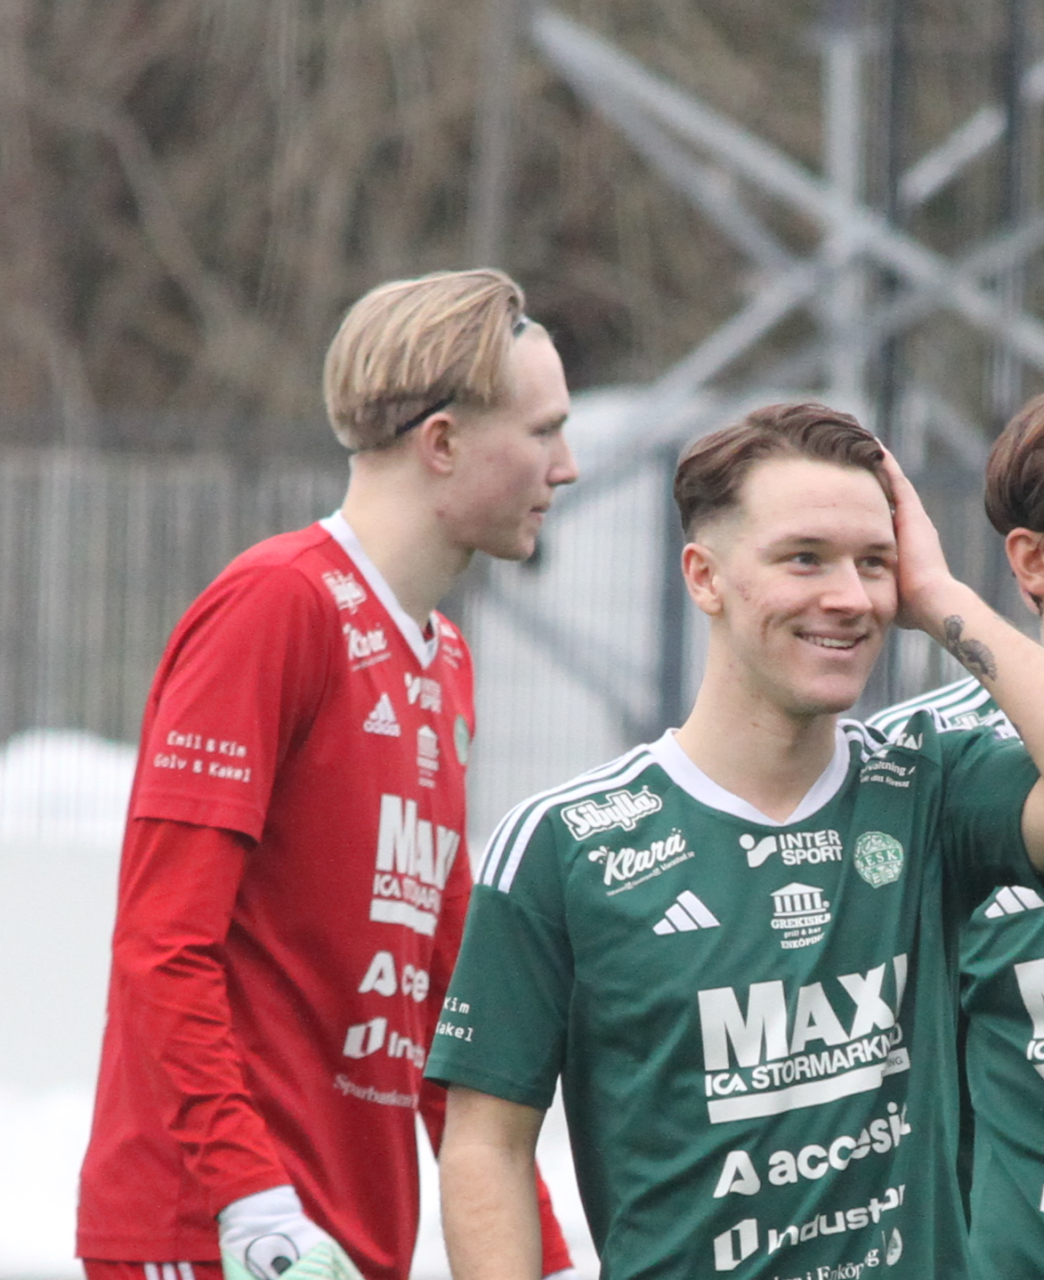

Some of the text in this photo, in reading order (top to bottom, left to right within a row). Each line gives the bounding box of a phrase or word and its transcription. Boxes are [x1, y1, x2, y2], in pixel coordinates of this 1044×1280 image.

[779, 829, 841, 850] INTER
[781, 846, 843, 867] SPORT
[705, 1073, 748, 1097] ICA
